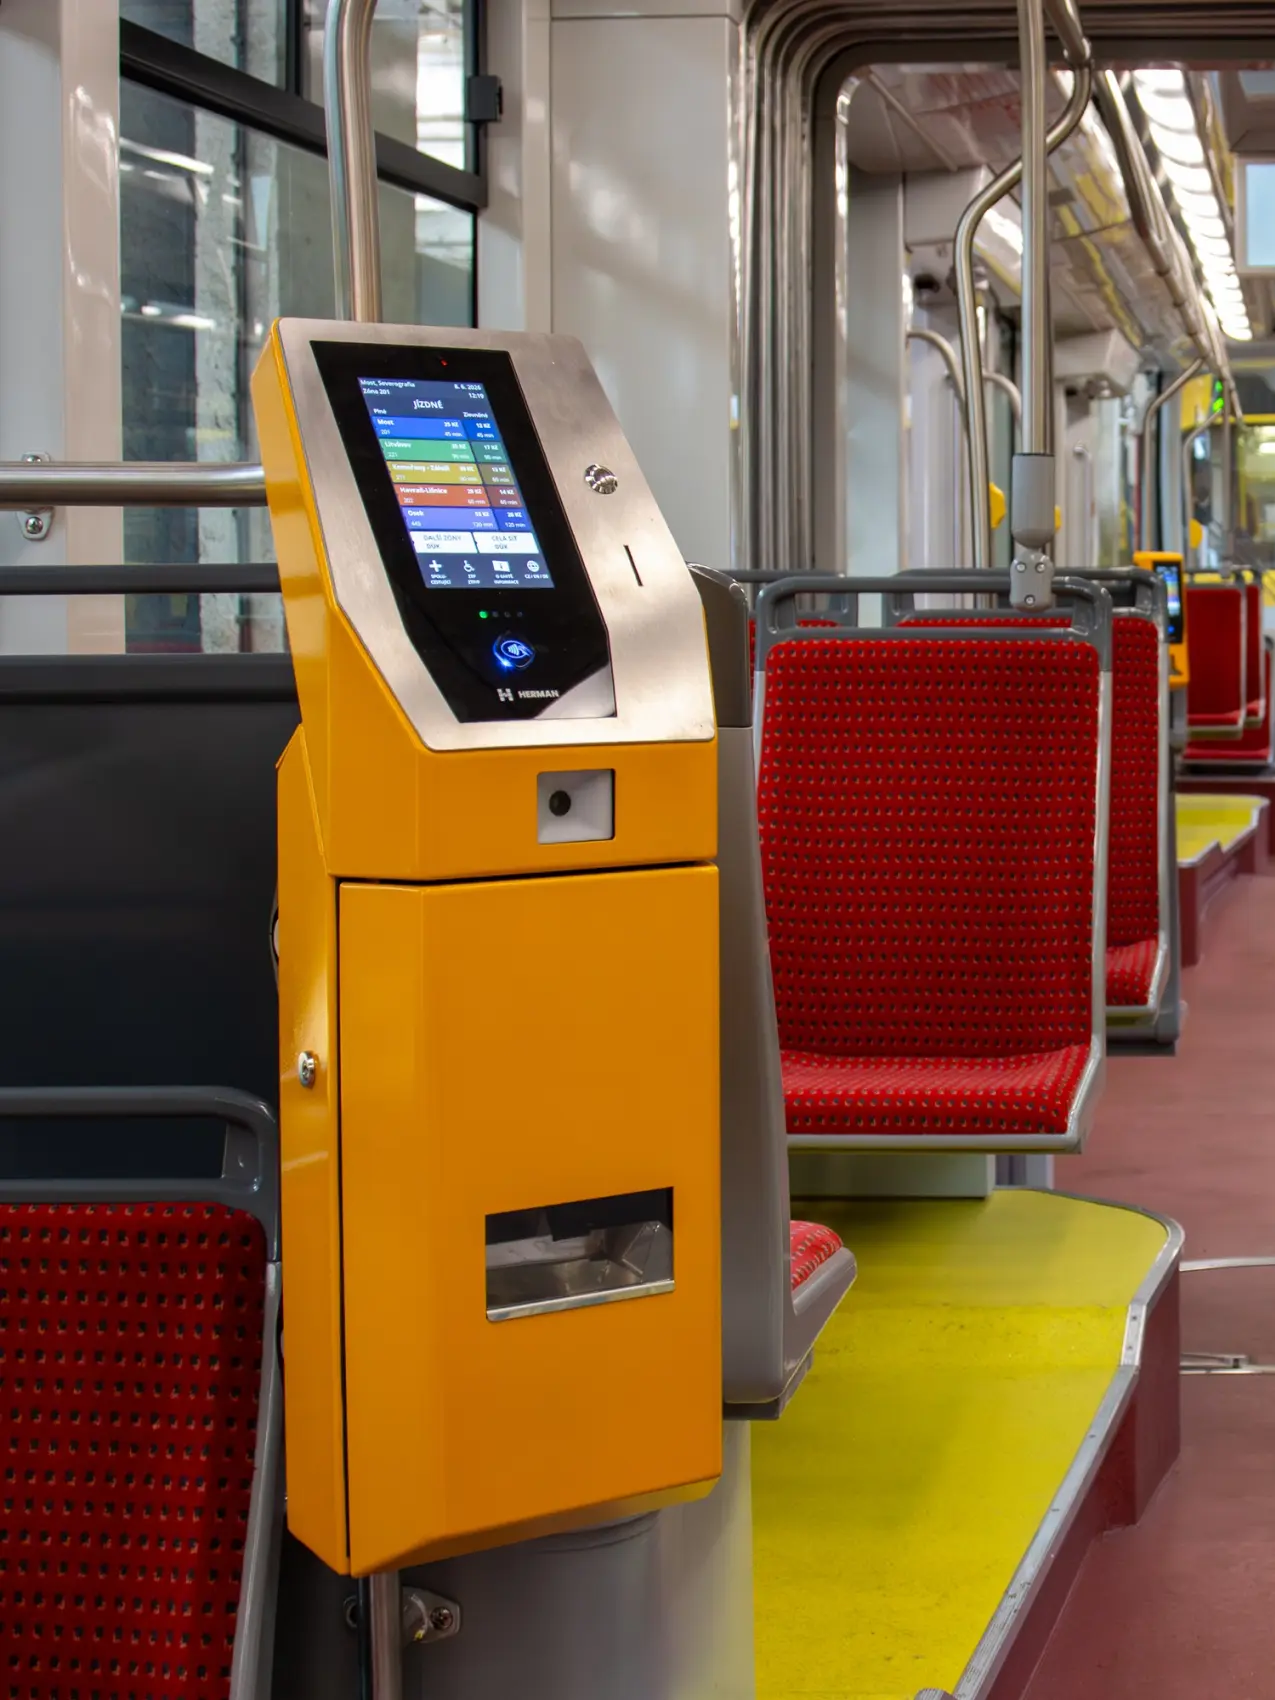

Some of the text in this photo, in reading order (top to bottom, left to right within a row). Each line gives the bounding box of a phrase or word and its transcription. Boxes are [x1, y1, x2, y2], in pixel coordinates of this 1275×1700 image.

[413, 399, 444, 410] JÍZDNÉ
[384, 440, 412, 448] Litvínov
[518, 690, 560, 699] HERMAN
